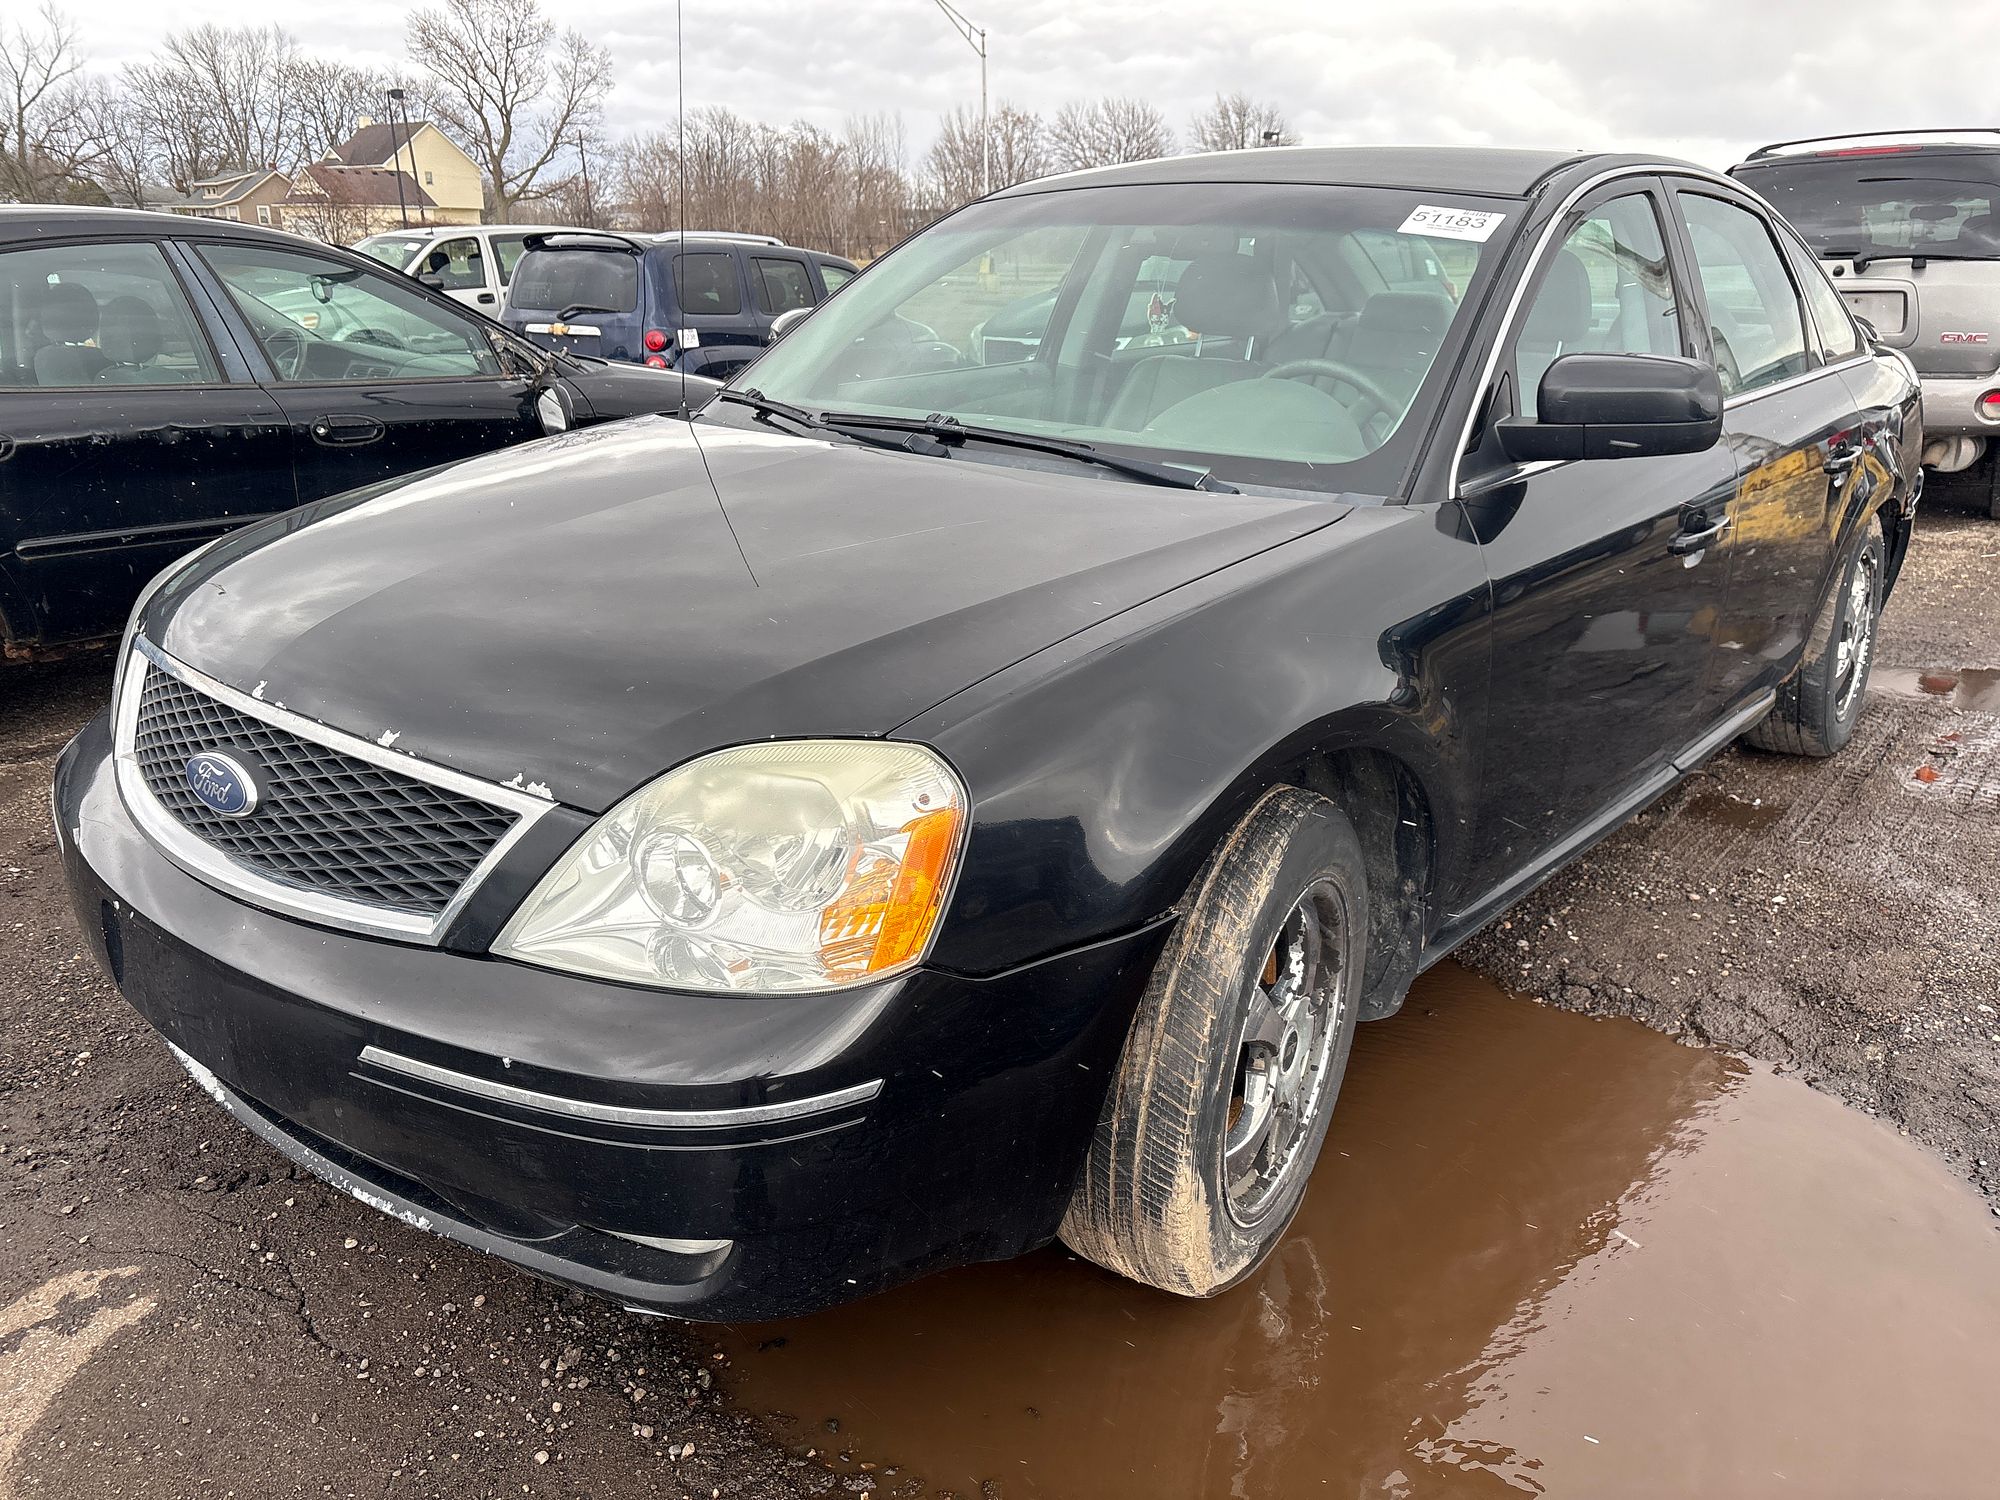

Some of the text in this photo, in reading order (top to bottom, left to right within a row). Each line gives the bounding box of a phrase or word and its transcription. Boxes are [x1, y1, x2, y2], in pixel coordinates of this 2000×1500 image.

[1412, 211, 1487, 229] 51183
[1940, 332, 1988, 344] GMC
[193, 761, 232, 804] Ford
